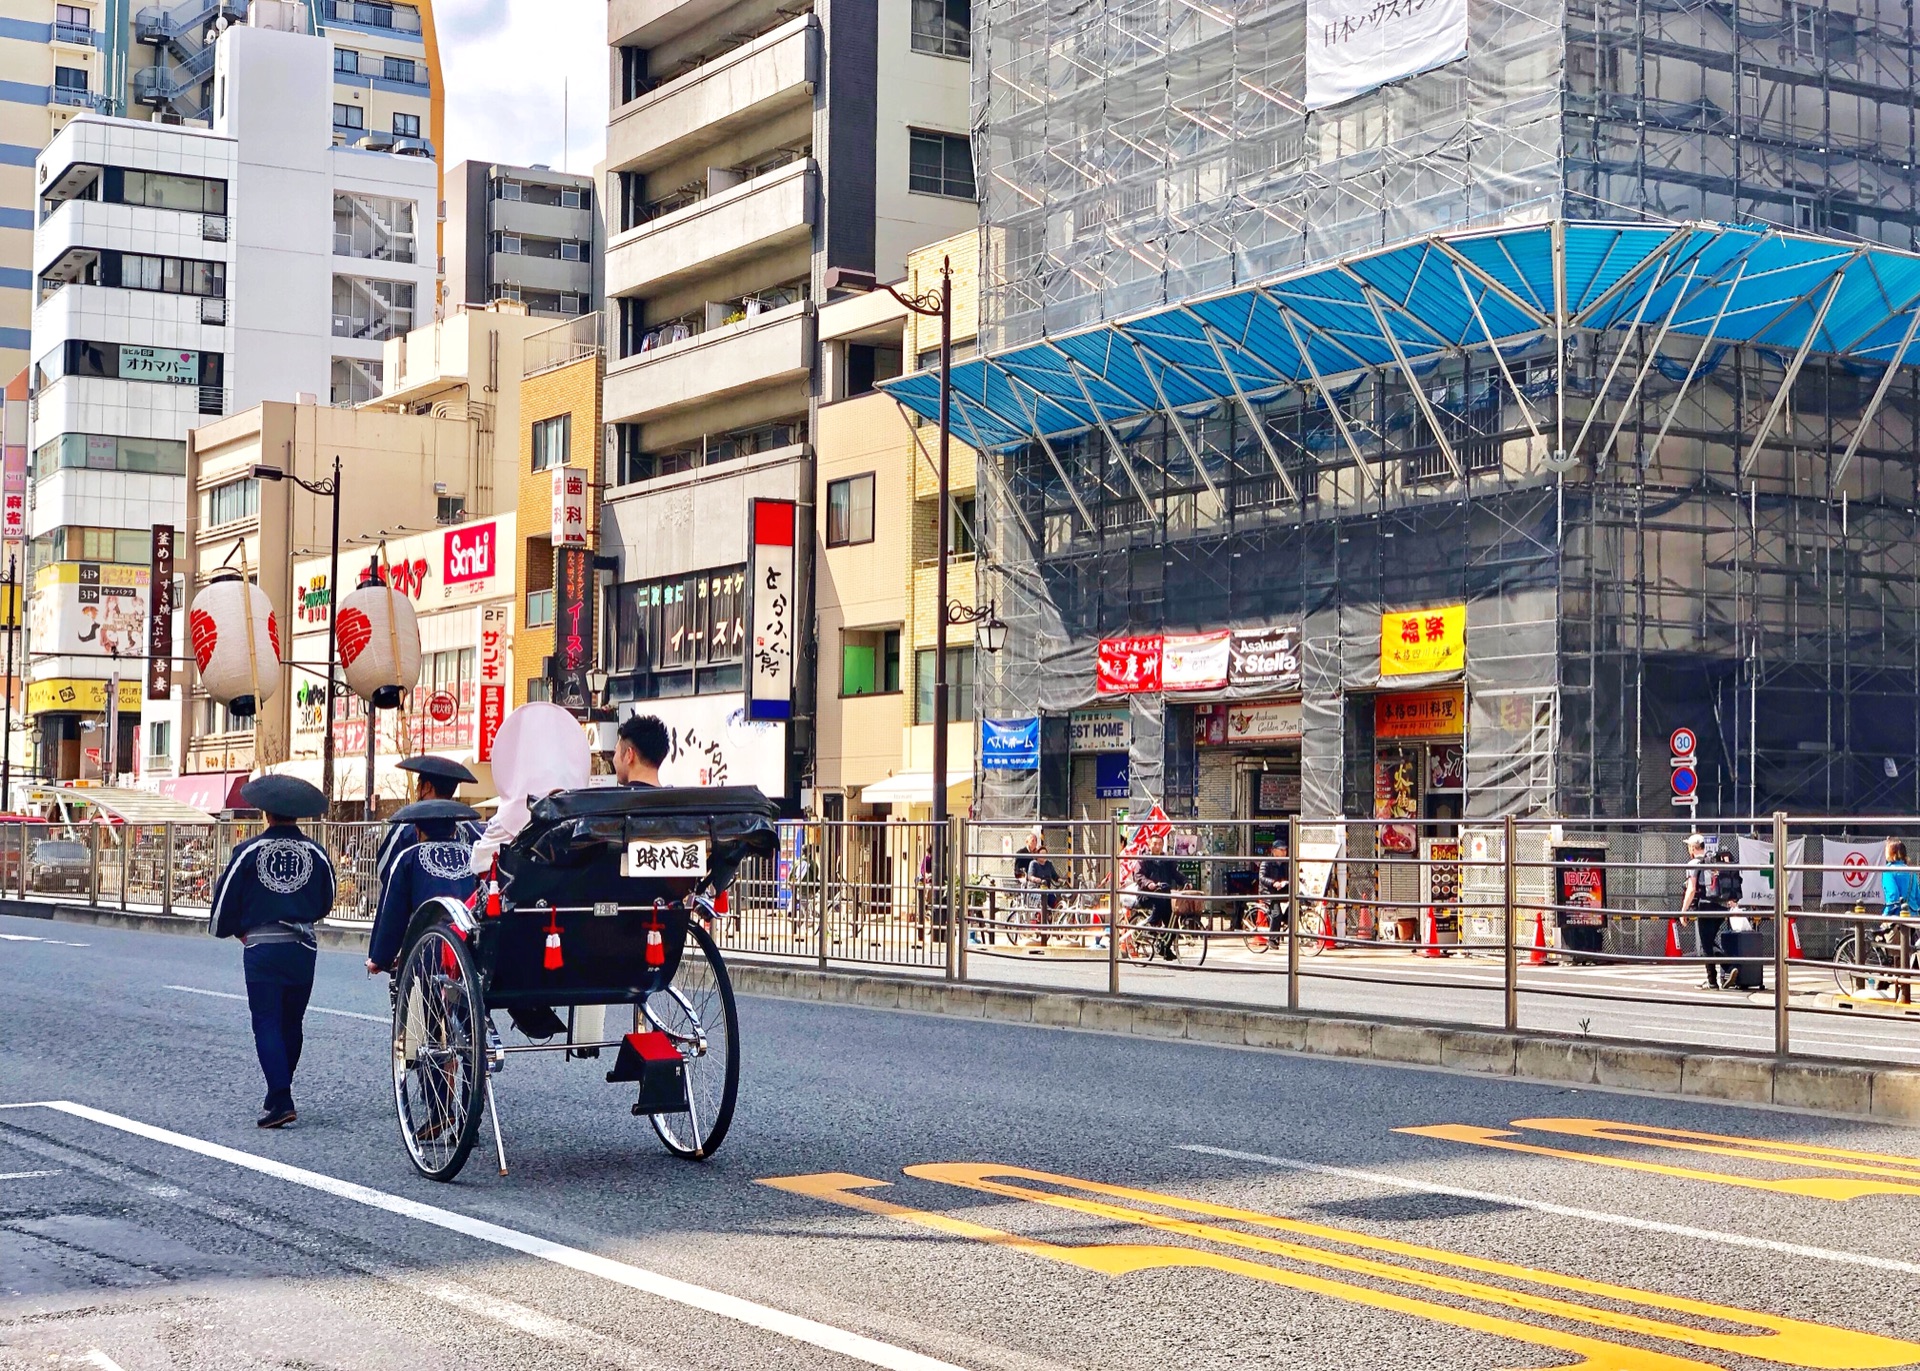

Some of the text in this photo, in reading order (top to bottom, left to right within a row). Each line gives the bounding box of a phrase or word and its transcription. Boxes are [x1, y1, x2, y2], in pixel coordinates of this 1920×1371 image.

[127, 358, 191, 373] オカマバー
[6, 495, 22, 525] 麻雀
[567, 476, 582, 524] 歯科
[157, 532, 171, 574] 釜めし
[450, 531, 489, 577] Sanki
[81, 569, 94, 577] 4F
[81, 590, 94, 599] 3F
[698, 573, 744, 599] カラオケ
[484, 610, 504, 621] 2F
[152, 615, 165, 648] 天ぷら
[567, 601, 584, 669] イースト
[671, 618, 744, 652] イースト
[482, 630, 499, 680] サンキ
[1240, 638, 1289, 654] Asakusa
[1245, 652, 1297, 674] Stella
[153, 659, 168, 692] 吾妻
[432, 702, 451, 714] 消火栓
[1093, 722, 1124, 738] HOME
[987, 735, 1034, 750] ベストホーム
[1676, 736, 1690, 749] 30
[636, 845, 699, 870] 時代屋
[1564, 872, 1600, 886] IBIZA
